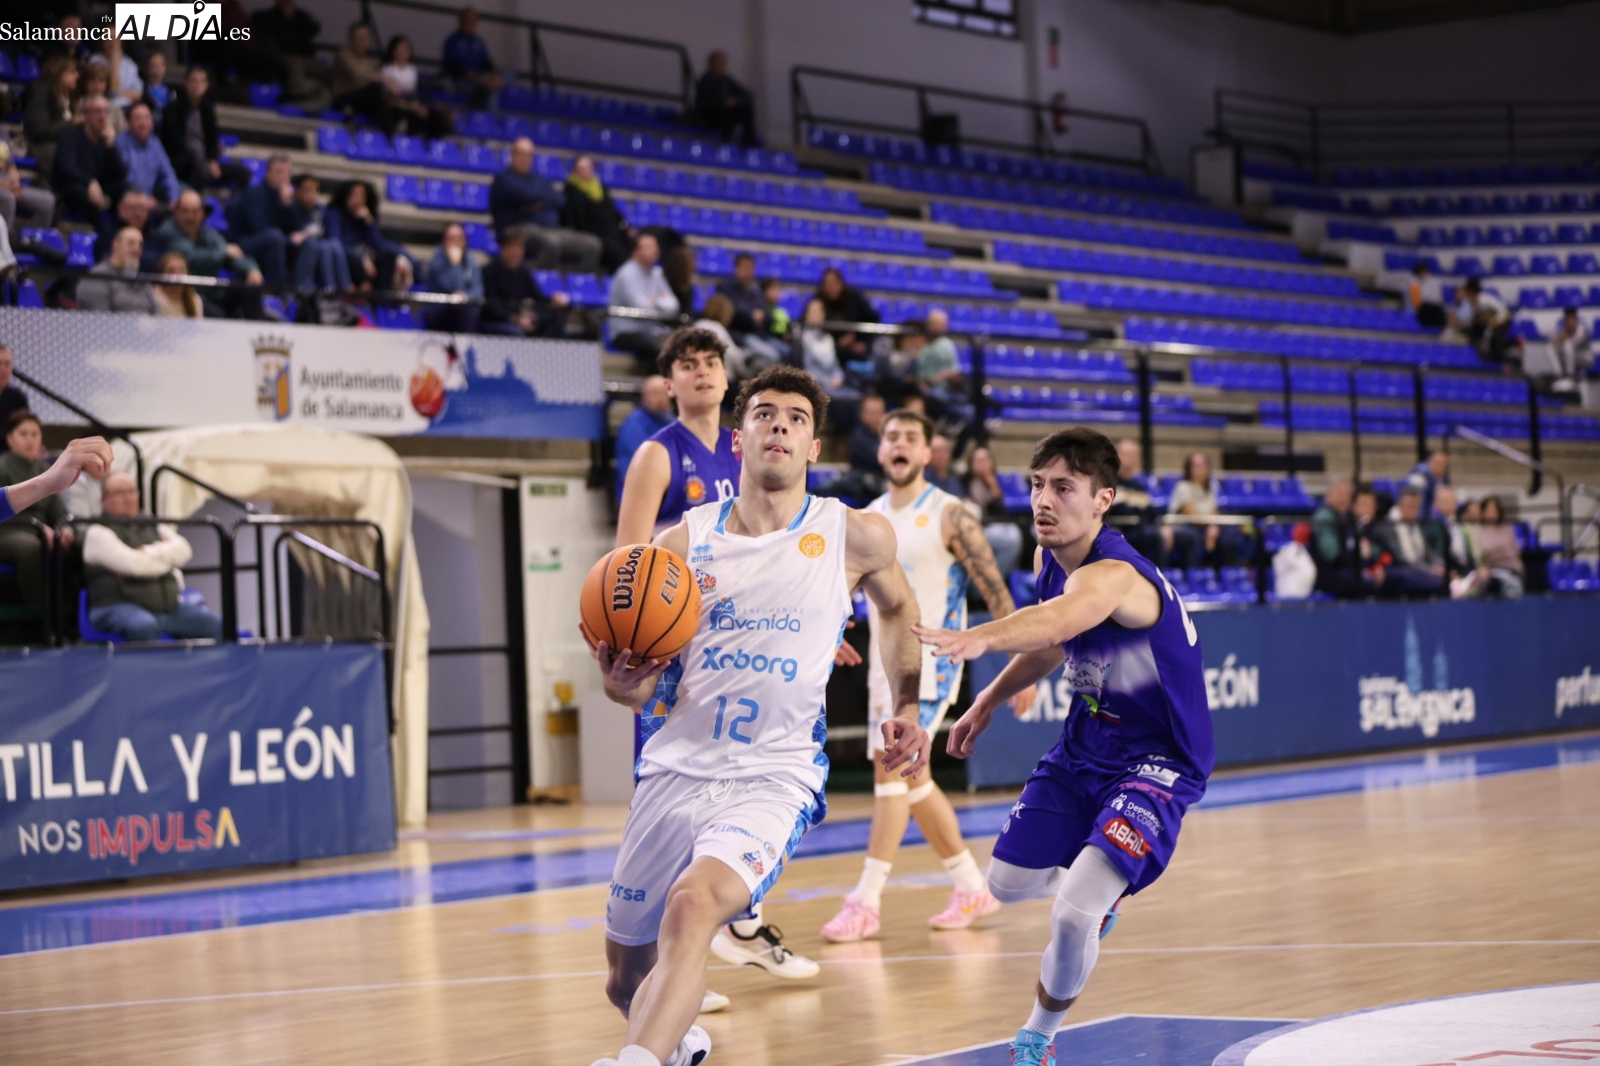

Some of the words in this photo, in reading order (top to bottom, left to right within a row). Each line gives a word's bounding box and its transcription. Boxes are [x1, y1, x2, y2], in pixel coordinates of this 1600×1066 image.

[300, 365, 404, 391] Ayuntamiento
[301, 396, 318, 417] de
[324, 396, 404, 419] Salamanca
[612, 546, 648, 612] Wilson
[712, 694, 759, 745] 12
[170, 732, 208, 803] Y
[229, 706, 356, 787] LEÓN
[18, 819, 83, 856] NOS
[87, 807, 241, 866] IMPULSA
[1106, 821, 1146, 856] ABRIL
